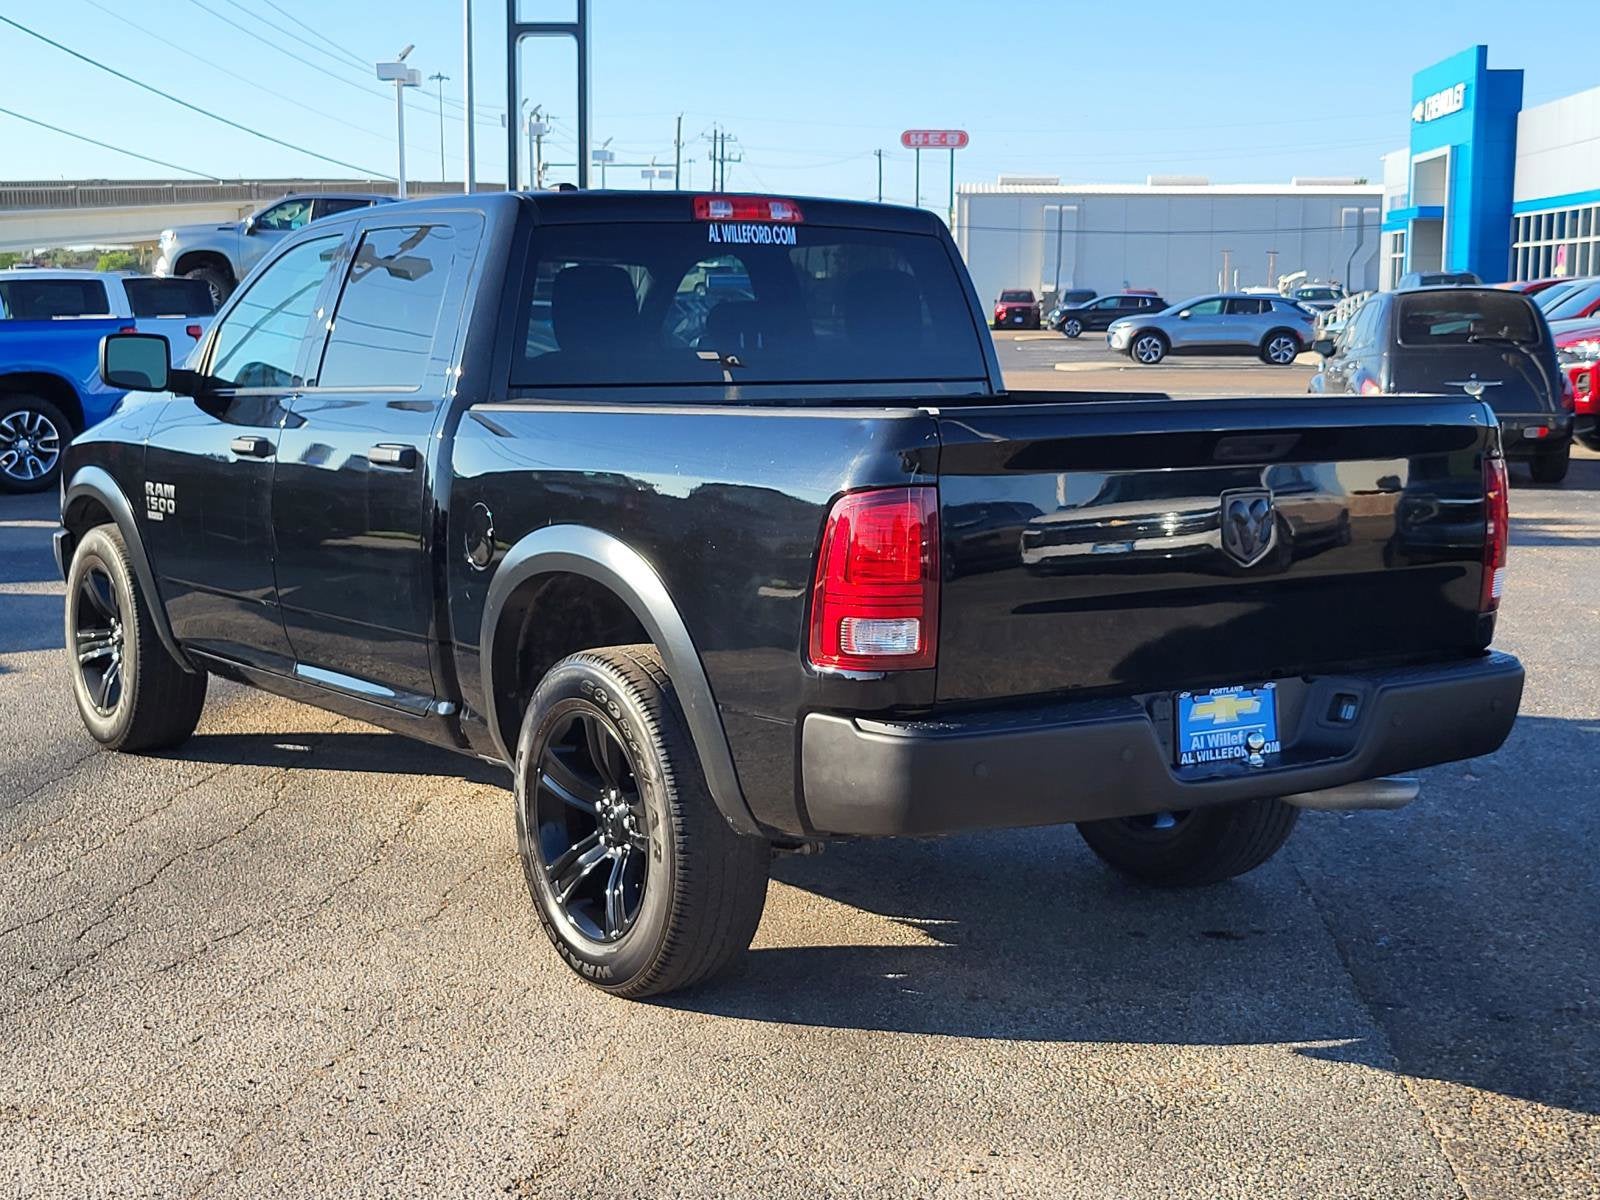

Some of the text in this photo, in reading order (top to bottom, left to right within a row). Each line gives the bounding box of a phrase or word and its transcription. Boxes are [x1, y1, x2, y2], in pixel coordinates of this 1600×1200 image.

[709, 224, 797, 245] AL WILLEFORD.COM
[145, 481, 175, 499] RAM
[146, 495, 175, 514] 1500
[1209, 685, 1244, 696] PORTLAND
[1191, 730, 1247, 750] Al Willef
[1181, 752, 1195, 765] AL
